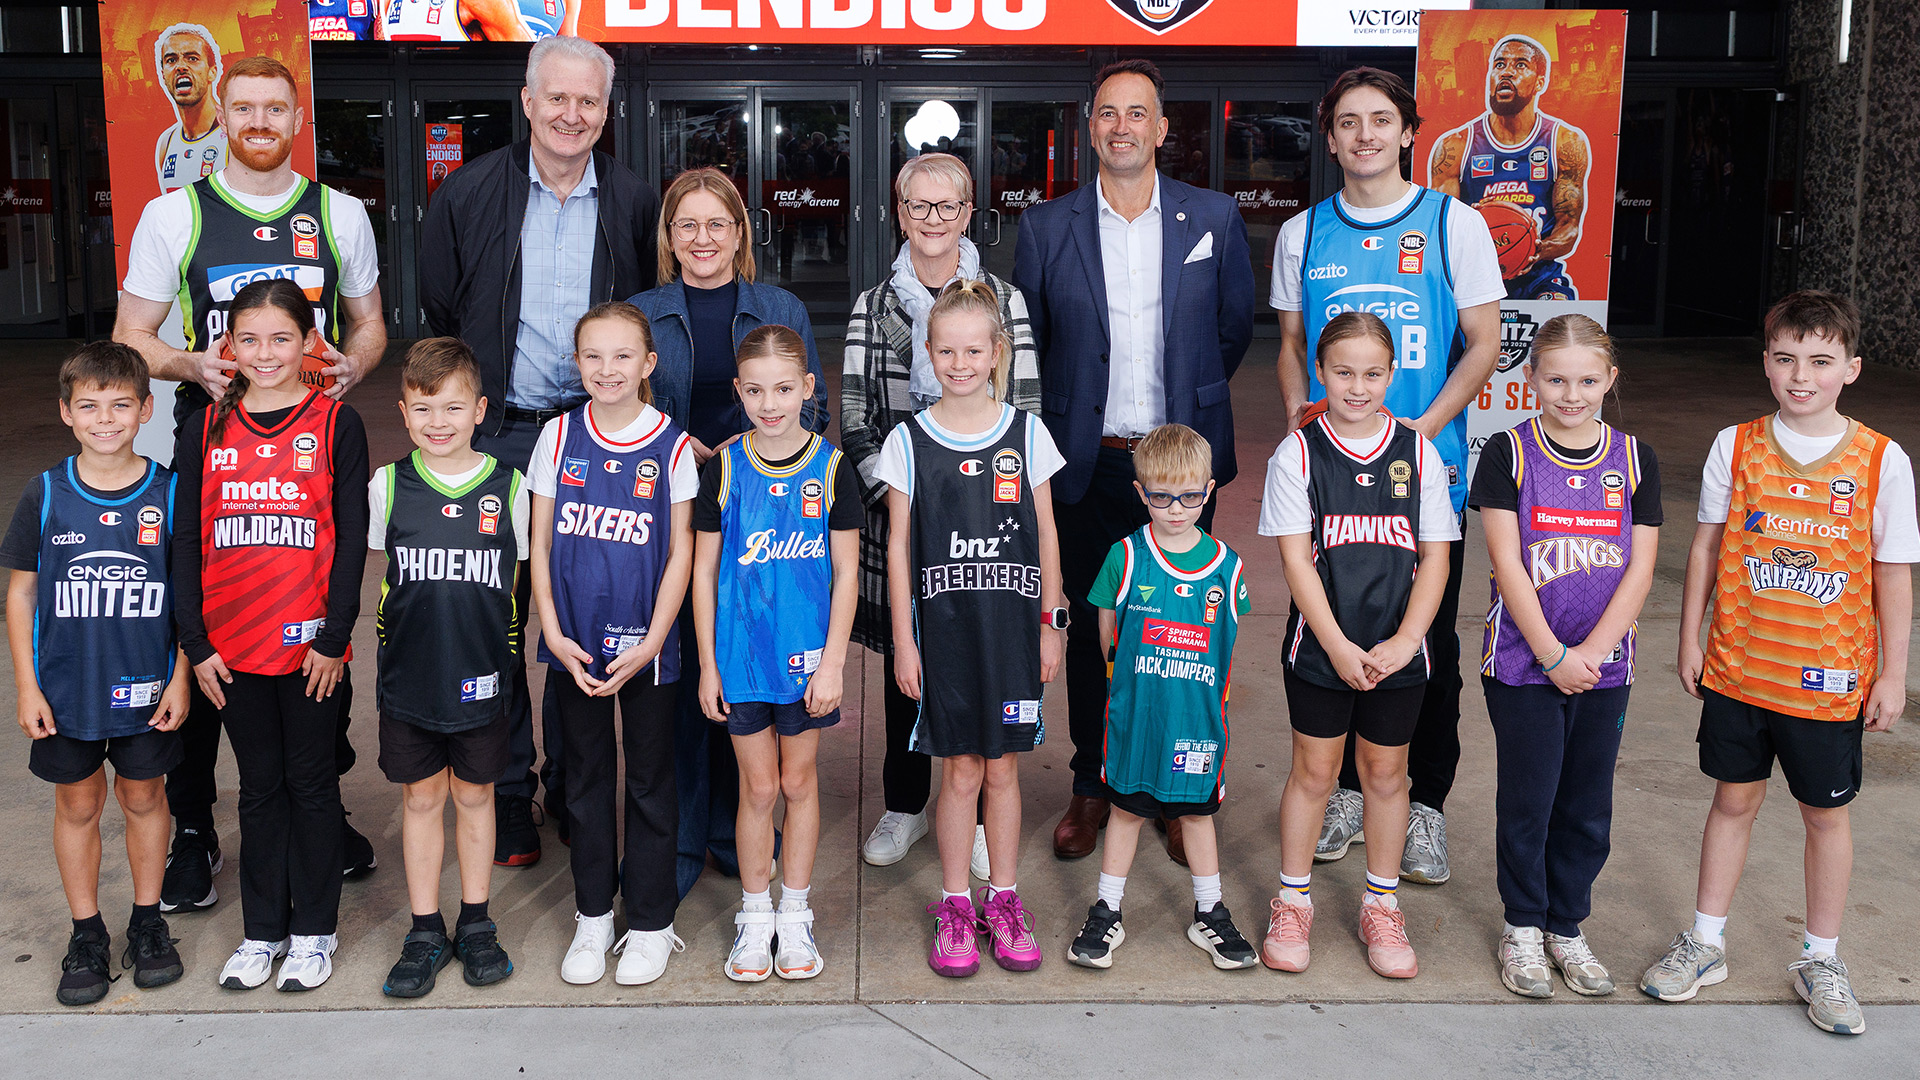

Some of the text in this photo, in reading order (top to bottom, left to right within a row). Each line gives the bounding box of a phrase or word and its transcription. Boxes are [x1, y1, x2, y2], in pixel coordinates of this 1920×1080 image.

[1349, 10, 1419, 25] VICTOR
[426, 150, 461, 160] ENDIGO
[774, 189, 797, 201] red
[1001, 189, 1025, 201] red
[1235, 189, 1257, 201] red
[1483, 181, 1529, 198] MEGA
[12, 198, 43, 206] arena
[809, 199, 840, 207] arena
[1006, 201, 1030, 209] energy
[1238, 199, 1299, 209] energy arena
[1621, 198, 1652, 207] arena
[1308, 263, 1348, 280] ozito
[1500, 311, 1518, 319] ODE
[1501, 323, 1535, 342] ITZ
[1393, 466, 1406, 476] NBL
[222, 501, 300, 511] internet mobile
[556, 501, 653, 545] SIXERS
[1537, 512, 1618, 528] Harvey Norman
[1766, 513, 1849, 540] Kenfrost
[51, 530, 86, 546] ozito
[214, 514, 317, 550] WILDCATS
[1322, 514, 1417, 552] HAWKS
[1765, 527, 1797, 540] Homes
[737, 528, 826, 566] Bullets
[949, 531, 1000, 559] bnz
[395, 546, 502, 589] PHOENIX
[1528, 537, 1623, 591] KINGS
[921, 562, 1041, 600] BREAKERS
[1744, 554, 1849, 605] TAIPANS
[55, 580, 165, 618] UNITED
[1127, 604, 1162, 613] MyStateBank
[1168, 627, 1196, 638] SPIRIT
[1167, 635, 1207, 648] TASMANIA
[1155, 646, 1200, 661] TASMANIA
[1134, 655, 1216, 687] JACKJUMPERS
[1192, 743, 1202, 751] THE
